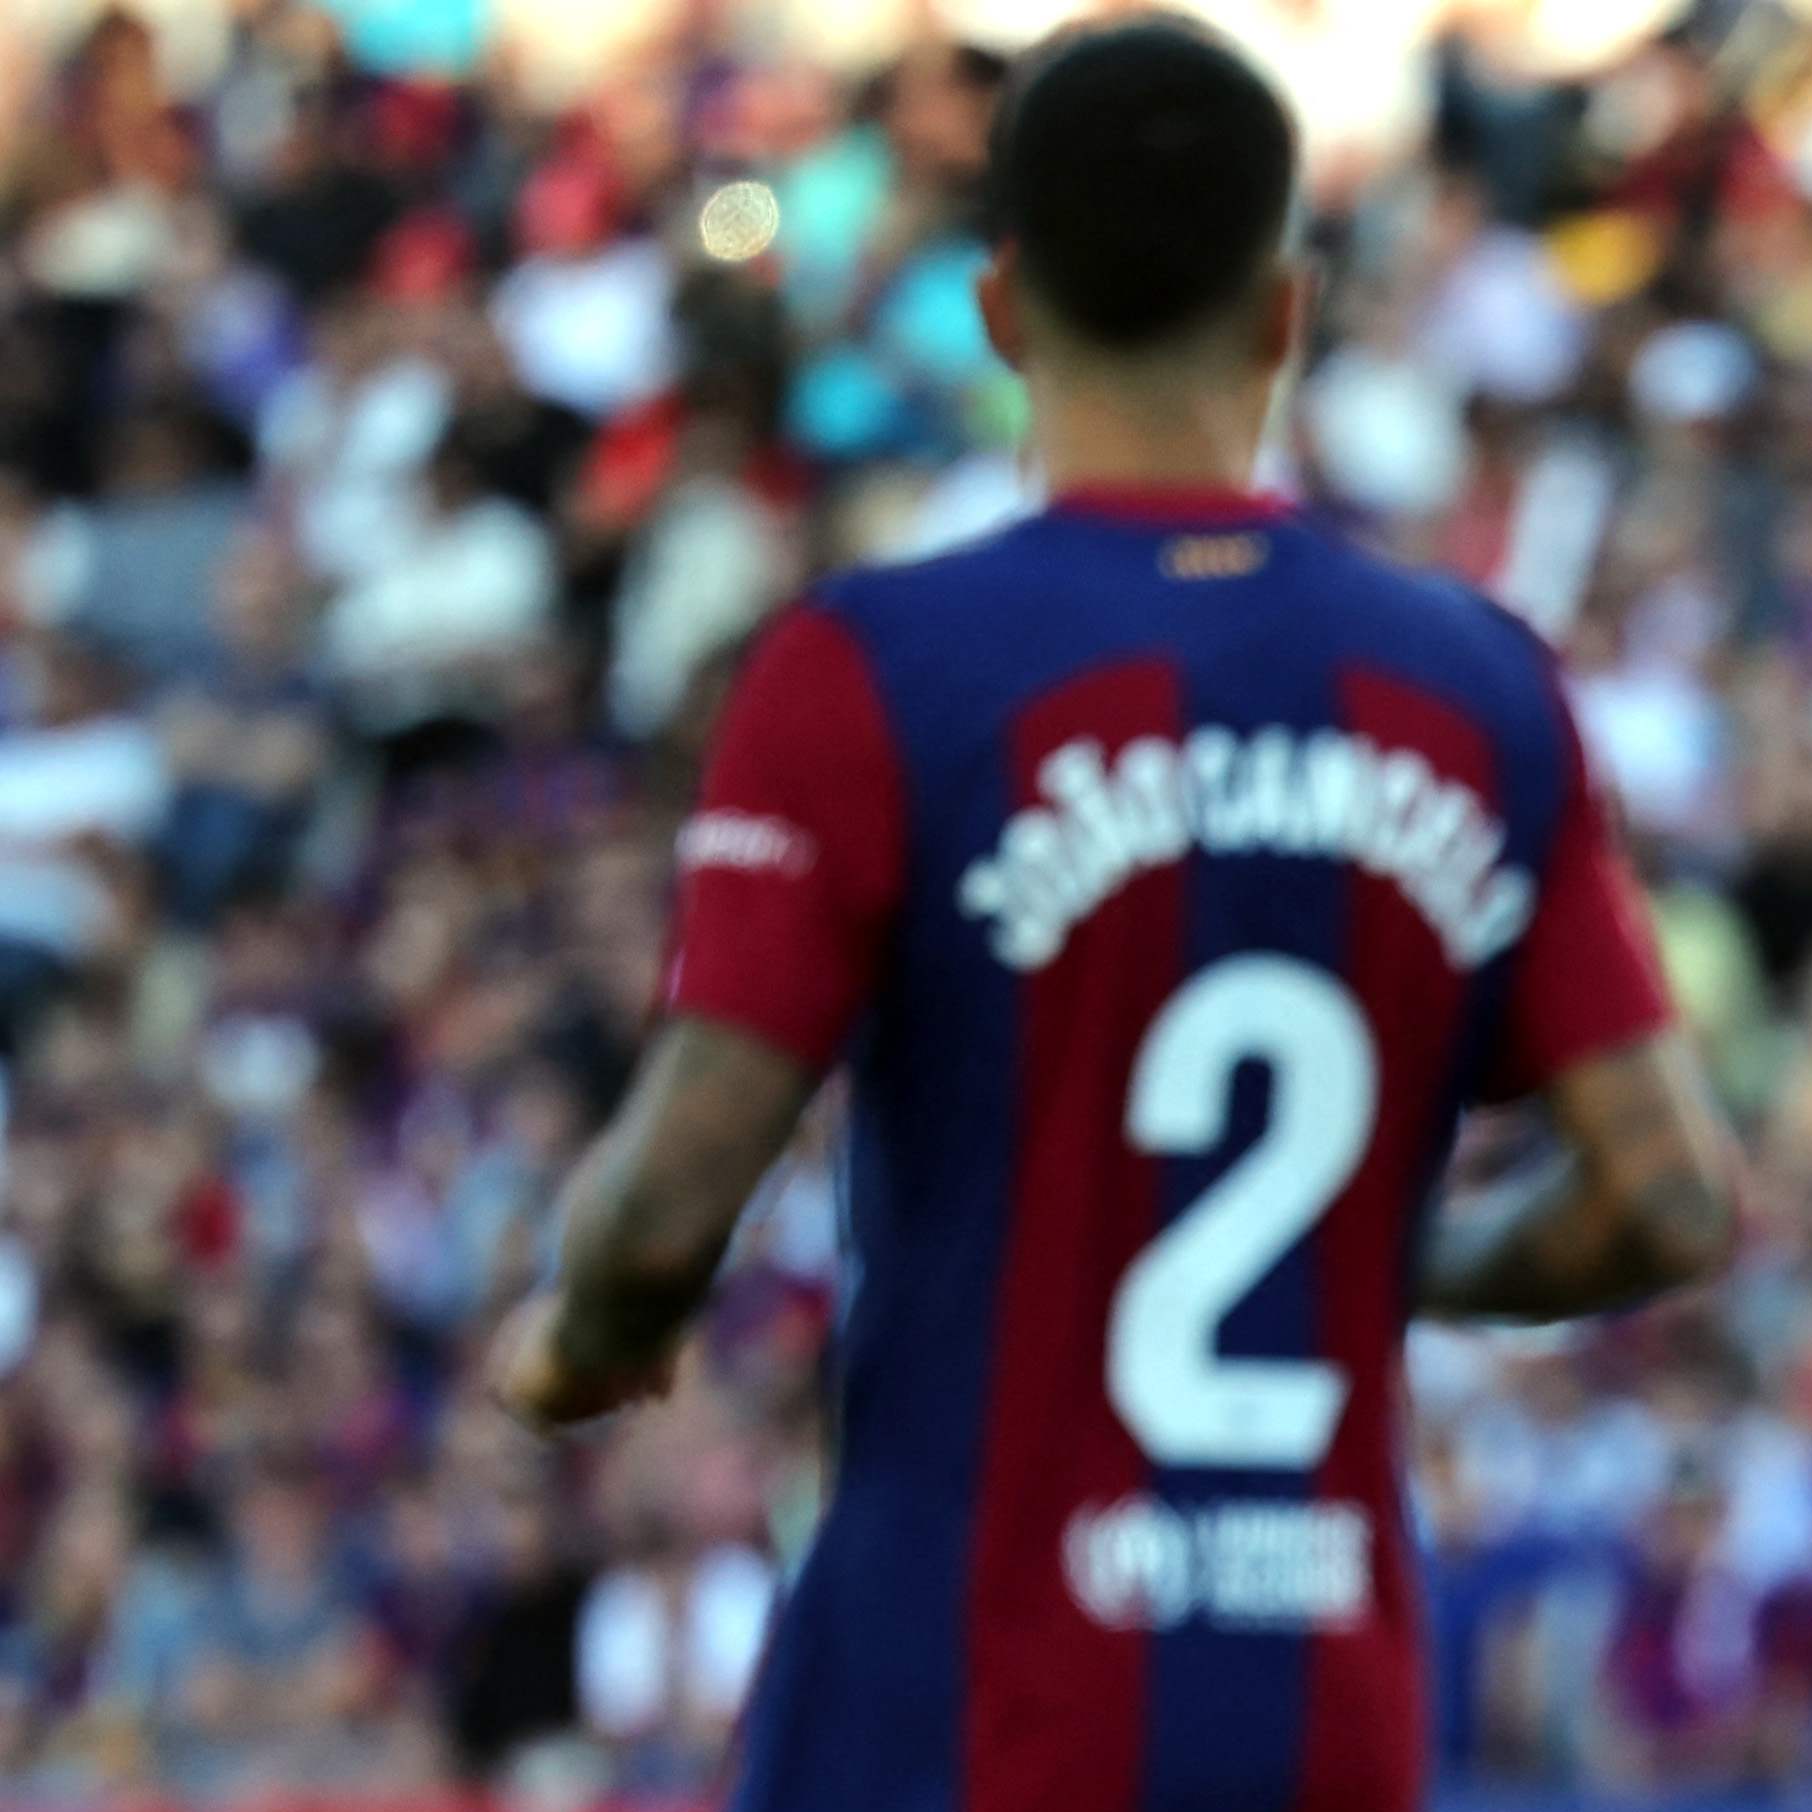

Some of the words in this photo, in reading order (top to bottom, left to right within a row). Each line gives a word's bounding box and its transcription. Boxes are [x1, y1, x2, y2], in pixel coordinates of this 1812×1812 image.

[957, 733, 1194, 970] JOÃO
[1181, 722, 1536, 970] CANCELO
[1108, 951, 1379, 1468] 2
